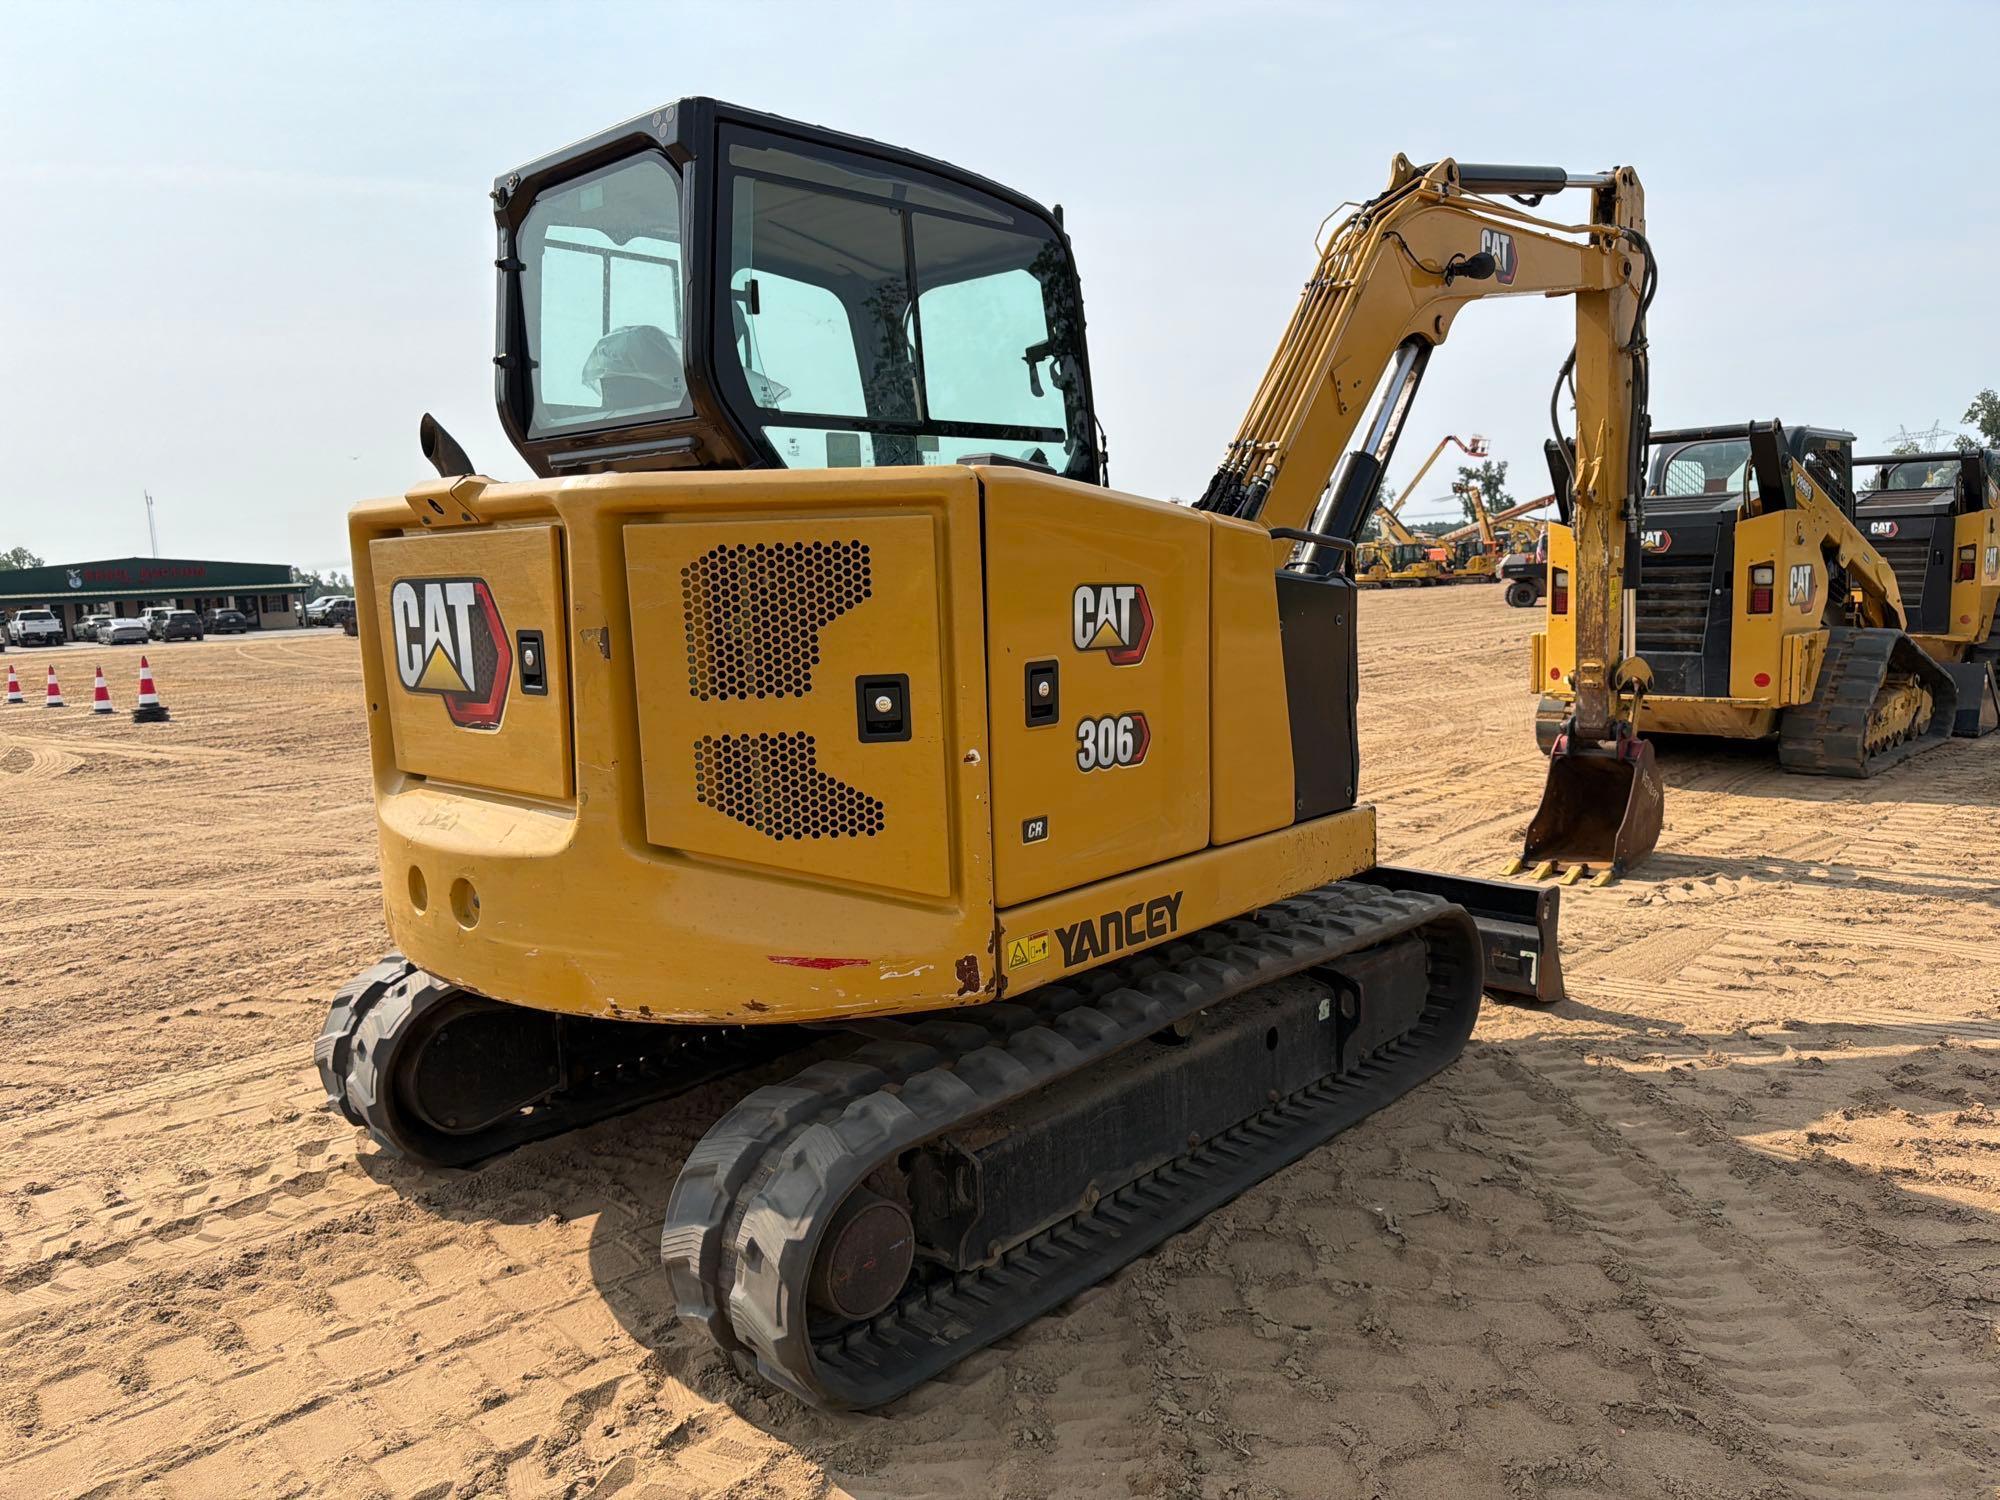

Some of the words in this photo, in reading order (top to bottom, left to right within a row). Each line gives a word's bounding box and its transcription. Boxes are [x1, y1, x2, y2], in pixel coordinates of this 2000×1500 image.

[1481, 229, 1511, 272] CAT
[1871, 521, 1892, 535] CAT
[1986, 547, 1999, 575] CAT
[1790, 565, 1812, 605] CAT
[392, 582, 476, 692] CAT
[1073, 585, 1136, 649] CAT
[1077, 715, 1135, 770] 306
[1027, 821, 1044, 839] CR
[1055, 890, 1184, 968] YANCEY
